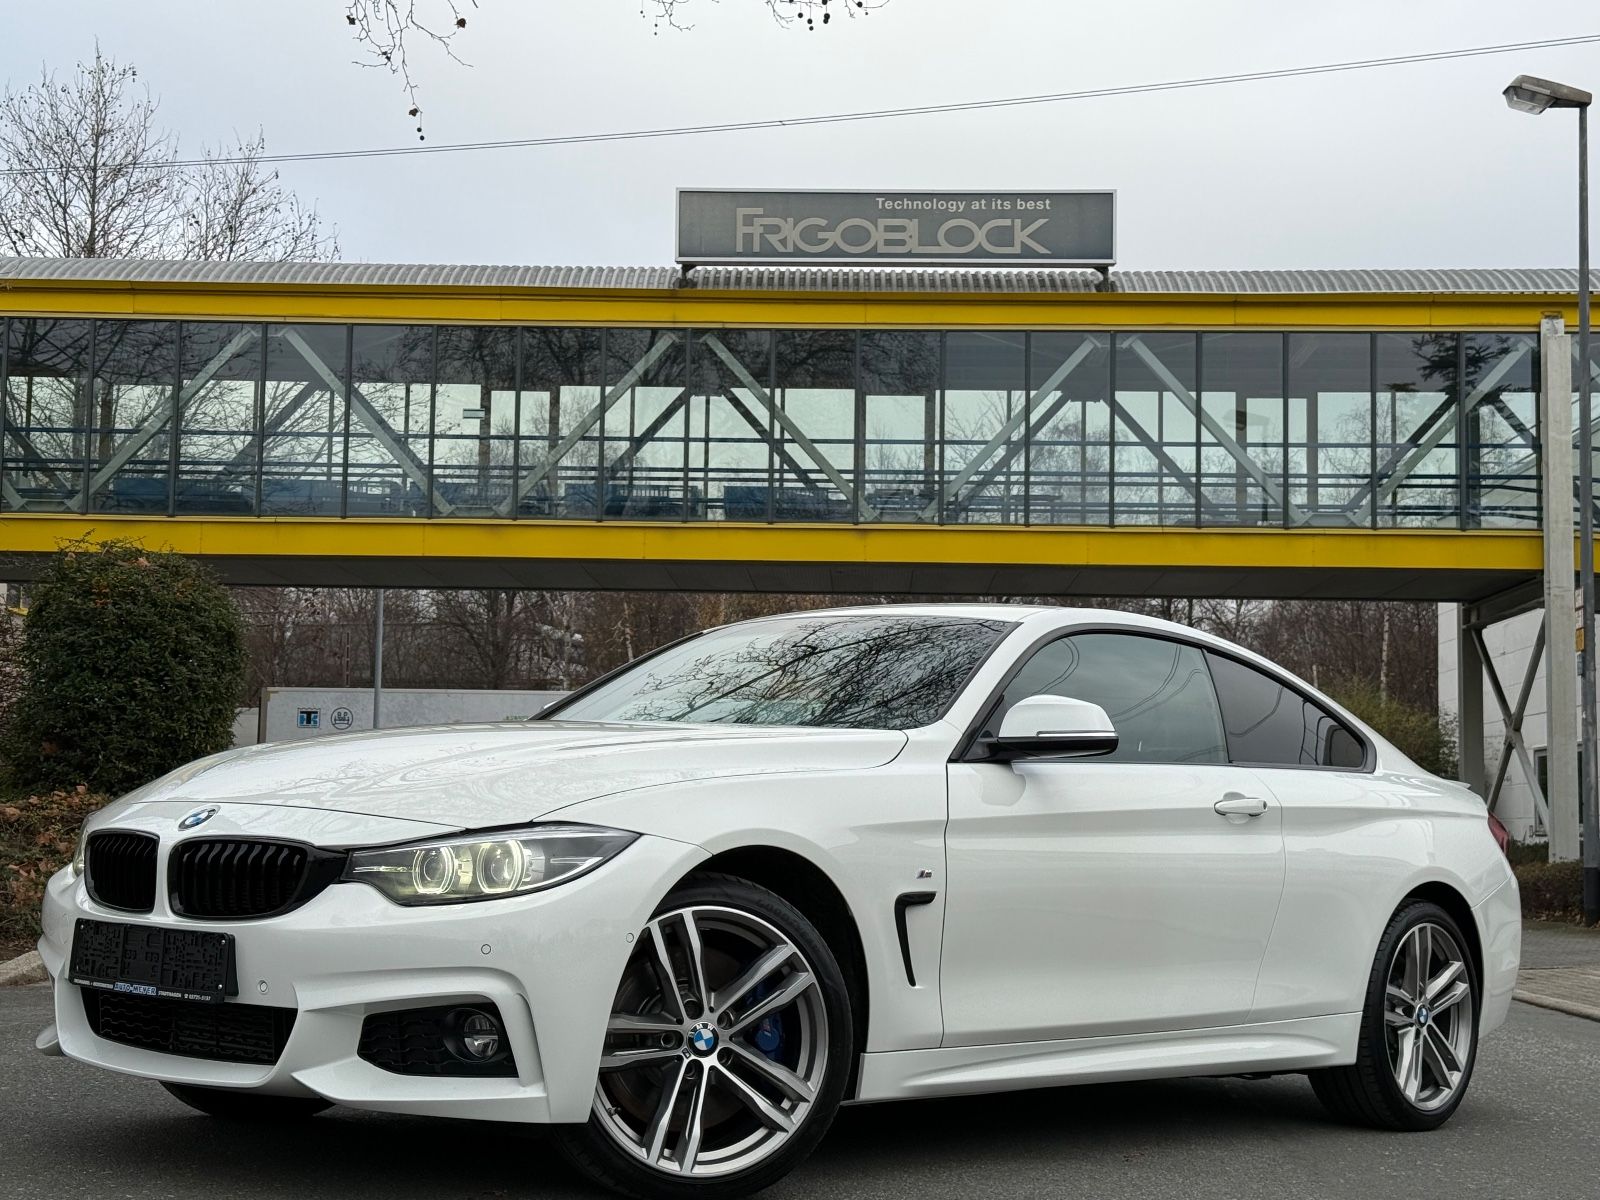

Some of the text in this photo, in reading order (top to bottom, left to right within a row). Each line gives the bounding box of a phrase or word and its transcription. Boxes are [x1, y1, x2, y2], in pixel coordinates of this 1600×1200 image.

[876, 197, 1051, 213] Technology at its best
[735, 207, 1052, 254] FRIGOBLOCK
